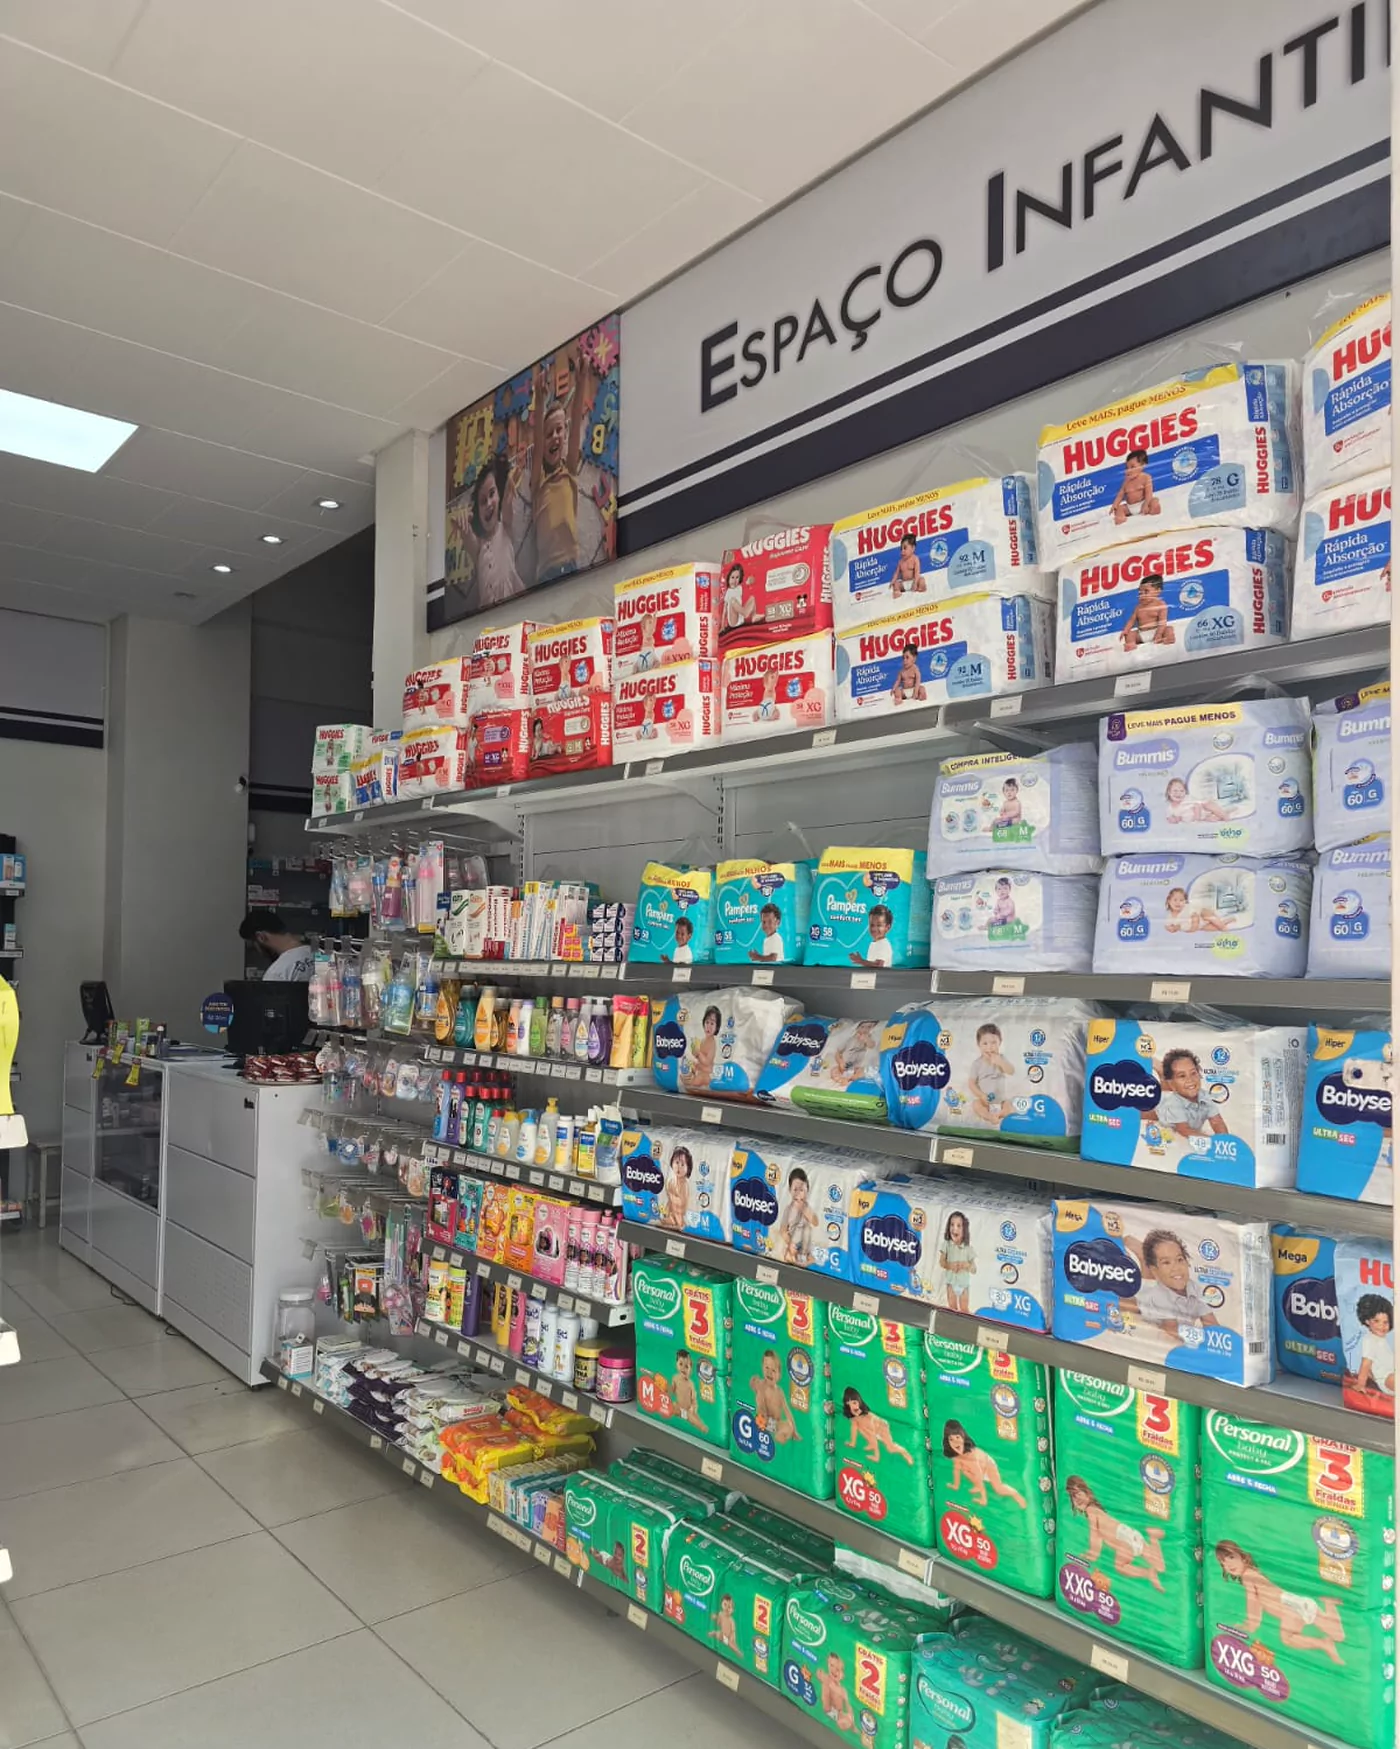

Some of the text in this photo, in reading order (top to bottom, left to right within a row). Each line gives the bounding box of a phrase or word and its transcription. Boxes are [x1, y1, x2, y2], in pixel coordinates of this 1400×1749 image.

[987, 0, 1391, 273] INFANTI
[1331, 375, 1372, 405] Rápida
[1332, 381, 1389, 417] Absorção
[1117, 399, 1147, 418] pague
[1149, 385, 1187, 405] MENOS
[1063, 407, 1198, 475] HUGGIES
[1256, 427, 1270, 494] HUGGIES
[1059, 478, 1092, 496] Rápida
[1227, 473, 1239, 486] G
[1060, 485, 1106, 506] Absorção
[858, 505, 953, 555] HUGGIES
[741, 526, 811, 559] HUGGIES
[1009, 520, 1020, 566] HUGGIES
[1324, 533, 1368, 553] Rápida
[973, 550, 984, 563] M
[1323, 543, 1385, 567] Absorção
[1080, 539, 1214, 597] HUGGIES
[618, 588, 680, 621] HUGGIES
[1076, 601, 1110, 617] Rápida
[1253, 568, 1265, 634] HUGGIES
[1076, 609, 1122, 627] Absorção
[1212, 615, 1235, 629] XG
[473, 635, 510, 653] HUGGIES
[534, 635, 587, 663] HUGGIES
[860, 617, 953, 661] HUGGIES
[735, 650, 804, 678] HUGGIES
[1007, 635, 1016, 680] HUGGIES
[970, 663, 982, 676] M
[620, 674, 676, 701] HUGGIES
[702, 695, 711, 736] HUGGIES
[806, 701, 821, 712] XG
[601, 701, 610, 746] HUGGIES
[678, 720, 691, 730] XG
[1128, 710, 1236, 730] LEVE MAIS PAGUE MENOS
[518, 710, 529, 753] HUGGIES
[1265, 732, 1304, 744] Bummis
[1117, 746, 1176, 766] Bummis
[942, 781, 979, 793] Bummis
[1347, 790, 1377, 806] 60 G
[1280, 804, 1292, 814] 60
[1019, 827, 1027, 835] M
[1121, 816, 1145, 830] 60 G
[1118, 860, 1179, 875] Bummis
[646, 903, 674, 923] Pampers
[725, 901, 758, 916] Pampers
[827, 894, 866, 914] Pampers
[823, 927, 832, 935] 58
[1014, 925, 1022, 933] M
[1120, 925, 1144, 937] 60 G
[1278, 925, 1290, 934] 60
[1334, 922, 1362, 935] 60 G
[656, 1035, 684, 1050] Babysec
[780, 1032, 822, 1049] Babysec
[1093, 1034, 1110, 1044] Hiper
[1325, 1038, 1346, 1048] Hiper
[725, 1066, 734, 1078] M
[895, 1062, 945, 1078] Babysec
[1094, 1078, 1155, 1100] Babysec
[1322, 1086, 1391, 1112] Babyse
[1034, 1100, 1045, 1112] G
[1314, 1128, 1355, 1144] ULTRA SEC
[1215, 1140, 1237, 1156] XXG
[626, 1166, 661, 1184] Babysec
[735, 1191, 774, 1214] Babysec
[864, 1228, 916, 1254] Babysec
[830, 1252, 839, 1264] G
[1278, 1249, 1307, 1263] Mega
[1069, 1254, 1134, 1282] Babysec
[638, 1280, 675, 1302] Personal
[684, 1287, 709, 1301] GRÁTIS
[741, 1281, 780, 1303] Personal
[1015, 1295, 1031, 1312] XG
[1085, 1301, 1099, 1311] SEC
[689, 1300, 709, 1336] 3
[792, 1300, 809, 1329] 3
[831, 1306, 871, 1329] Personal
[884, 1323, 900, 1342] 3
[1207, 1330, 1232, 1350] XXG
[929, 1334, 975, 1355] Personal
[1285, 1340, 1335, 1362] ULTRA SEC
[642, 1381, 654, 1396] M
[1145, 1395, 1171, 1433] 3
[739, 1414, 752, 1438] G
[1215, 1416, 1291, 1451] Personal
[1142, 1430, 1173, 1447] Fraldas
[1238, 1443, 1267, 1458] baby
[1318, 1448, 1353, 1492] 3
[842, 1474, 881, 1504] XG 50
[1315, 1489, 1356, 1506] Fraldas
[568, 1496, 593, 1515] Personal
[635, 1533, 646, 1554] 2
[947, 1518, 990, 1551] XG 50
[684, 1562, 711, 1583] Personal
[1064, 1569, 1114, 1607] XXG 50
[757, 1606, 767, 1624] 2
[789, 1605, 821, 1634] Personal
[1217, 1641, 1280, 1681] XXG 50
[789, 1665, 799, 1681] G
[861, 1660, 881, 1694] 2
[919, 1679, 972, 1721] Personal
